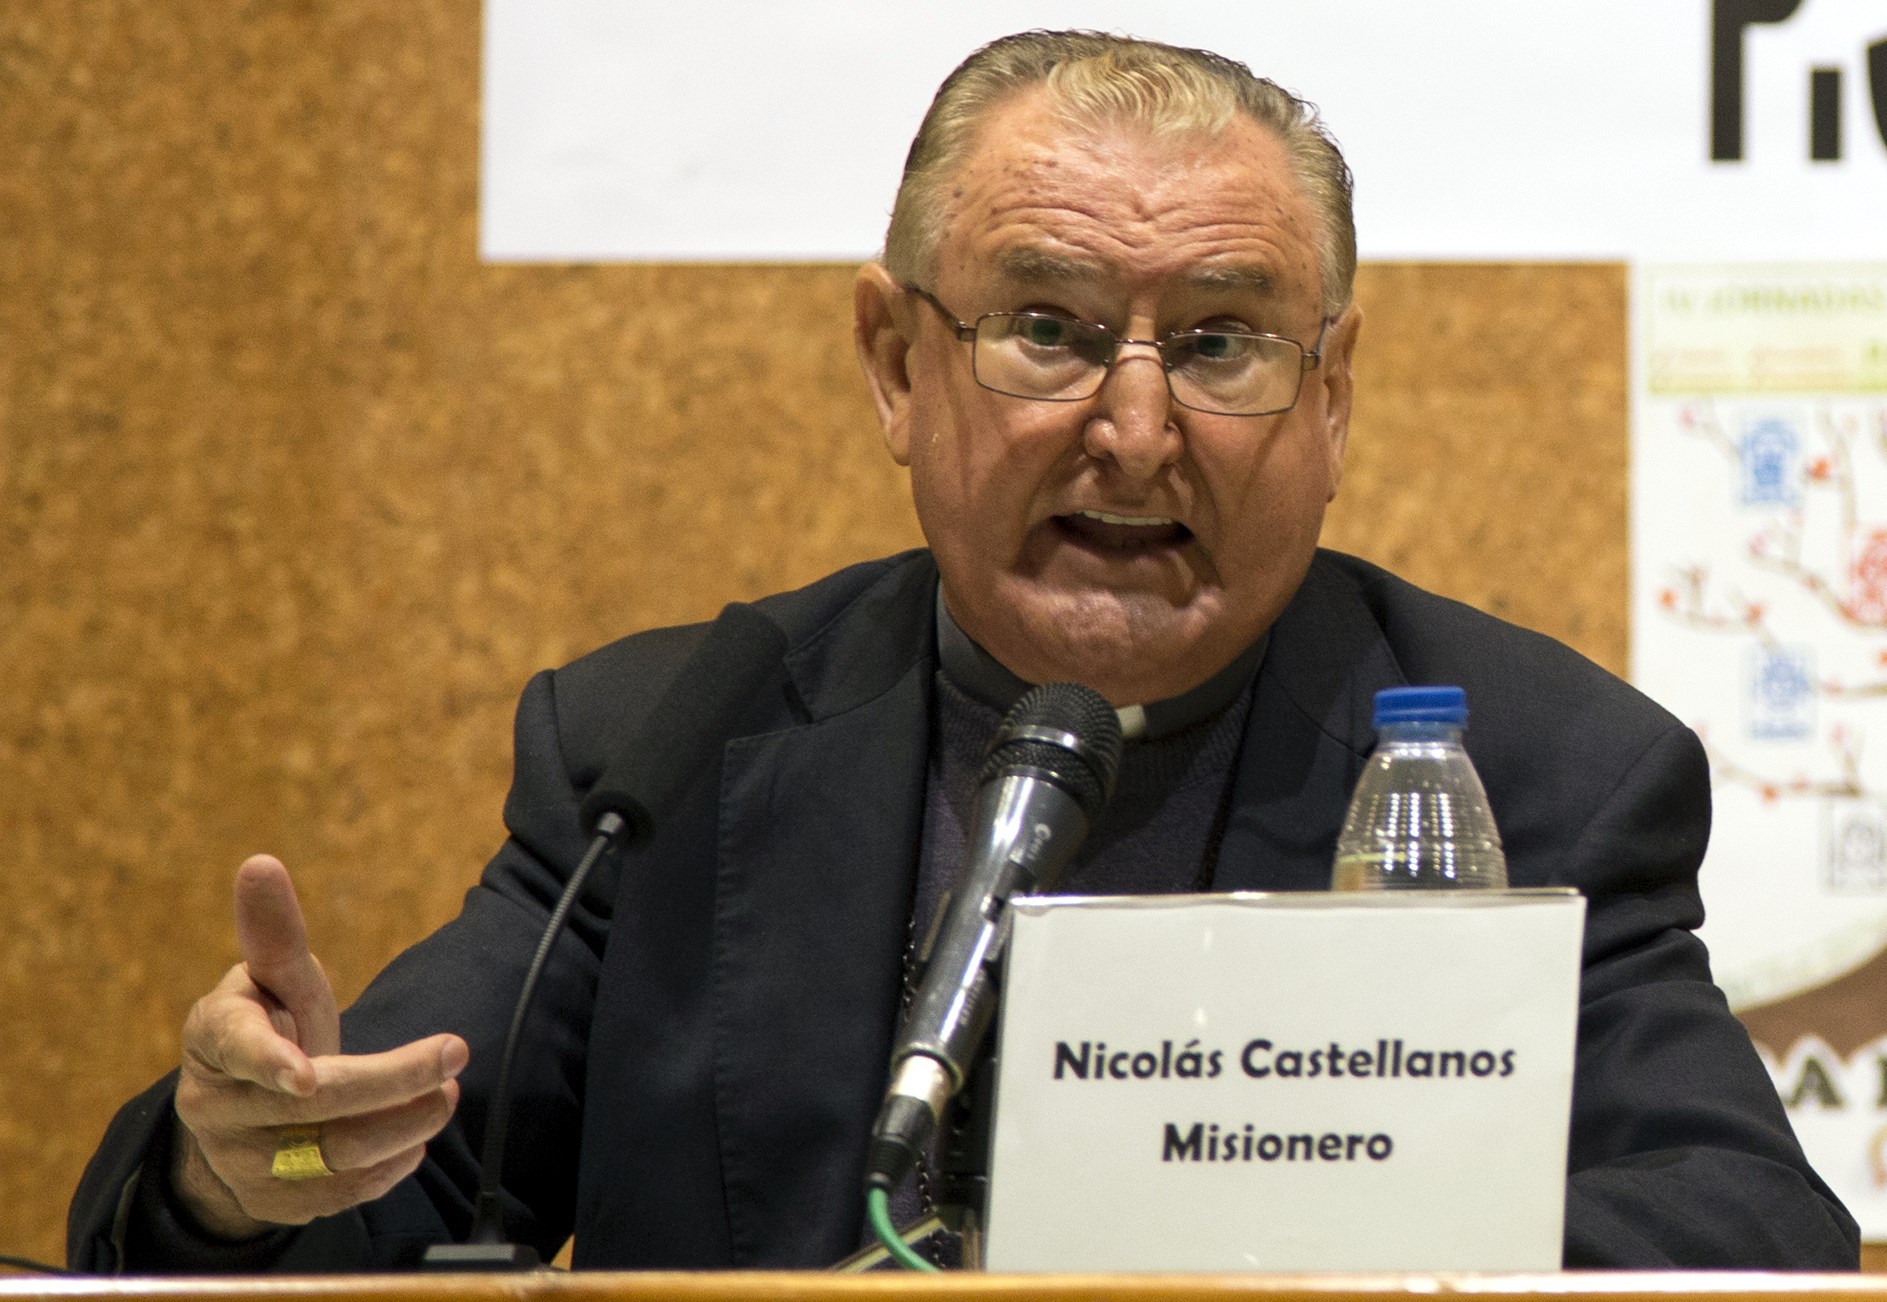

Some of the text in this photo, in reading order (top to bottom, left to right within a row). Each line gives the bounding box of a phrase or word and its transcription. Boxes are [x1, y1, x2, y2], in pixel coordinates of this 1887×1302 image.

[1053, 1038, 1516, 1080] Nicolás Castellanos
[1162, 1122, 1393, 1162] Misionero
